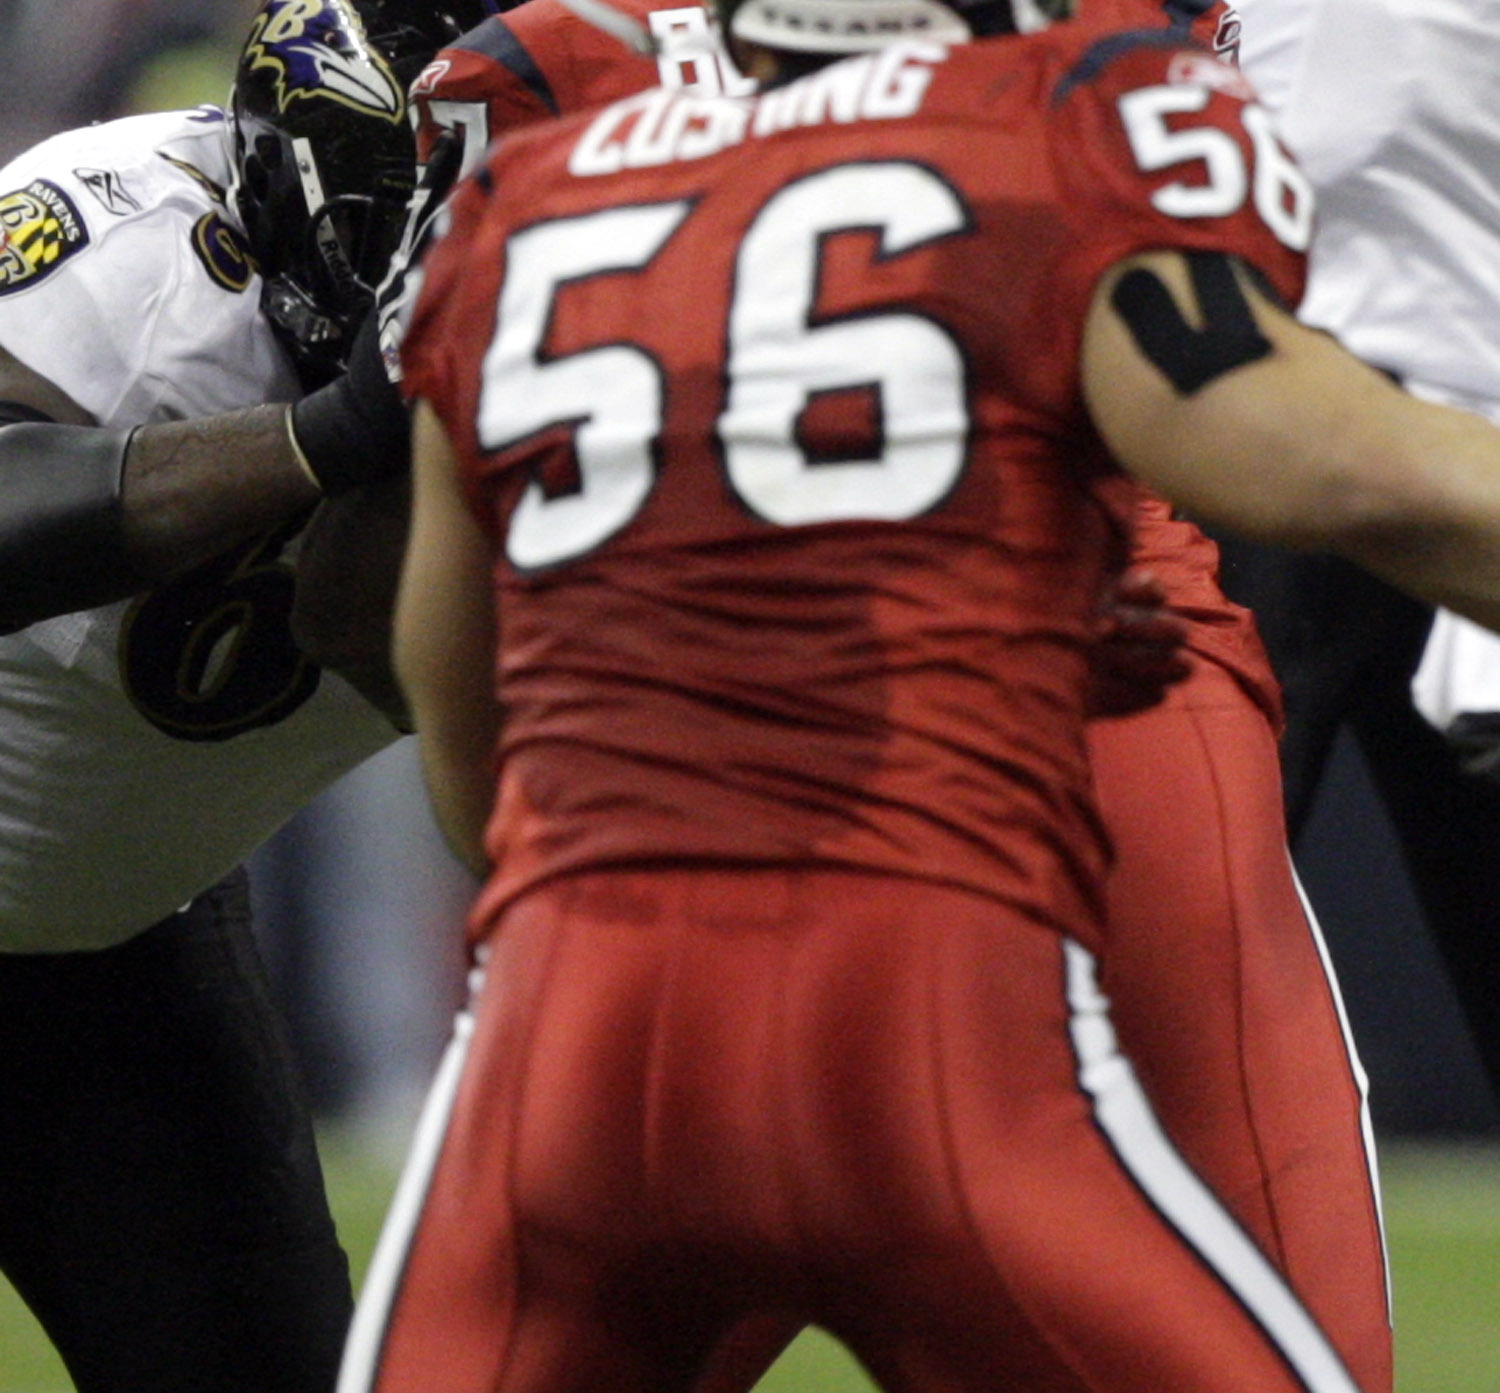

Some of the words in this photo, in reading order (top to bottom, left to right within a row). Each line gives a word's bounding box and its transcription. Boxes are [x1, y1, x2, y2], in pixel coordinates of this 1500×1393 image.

[28, 181, 81, 243] RAVENS
[1117, 83, 1316, 252] 56
[477, 160, 974, 576] 56
